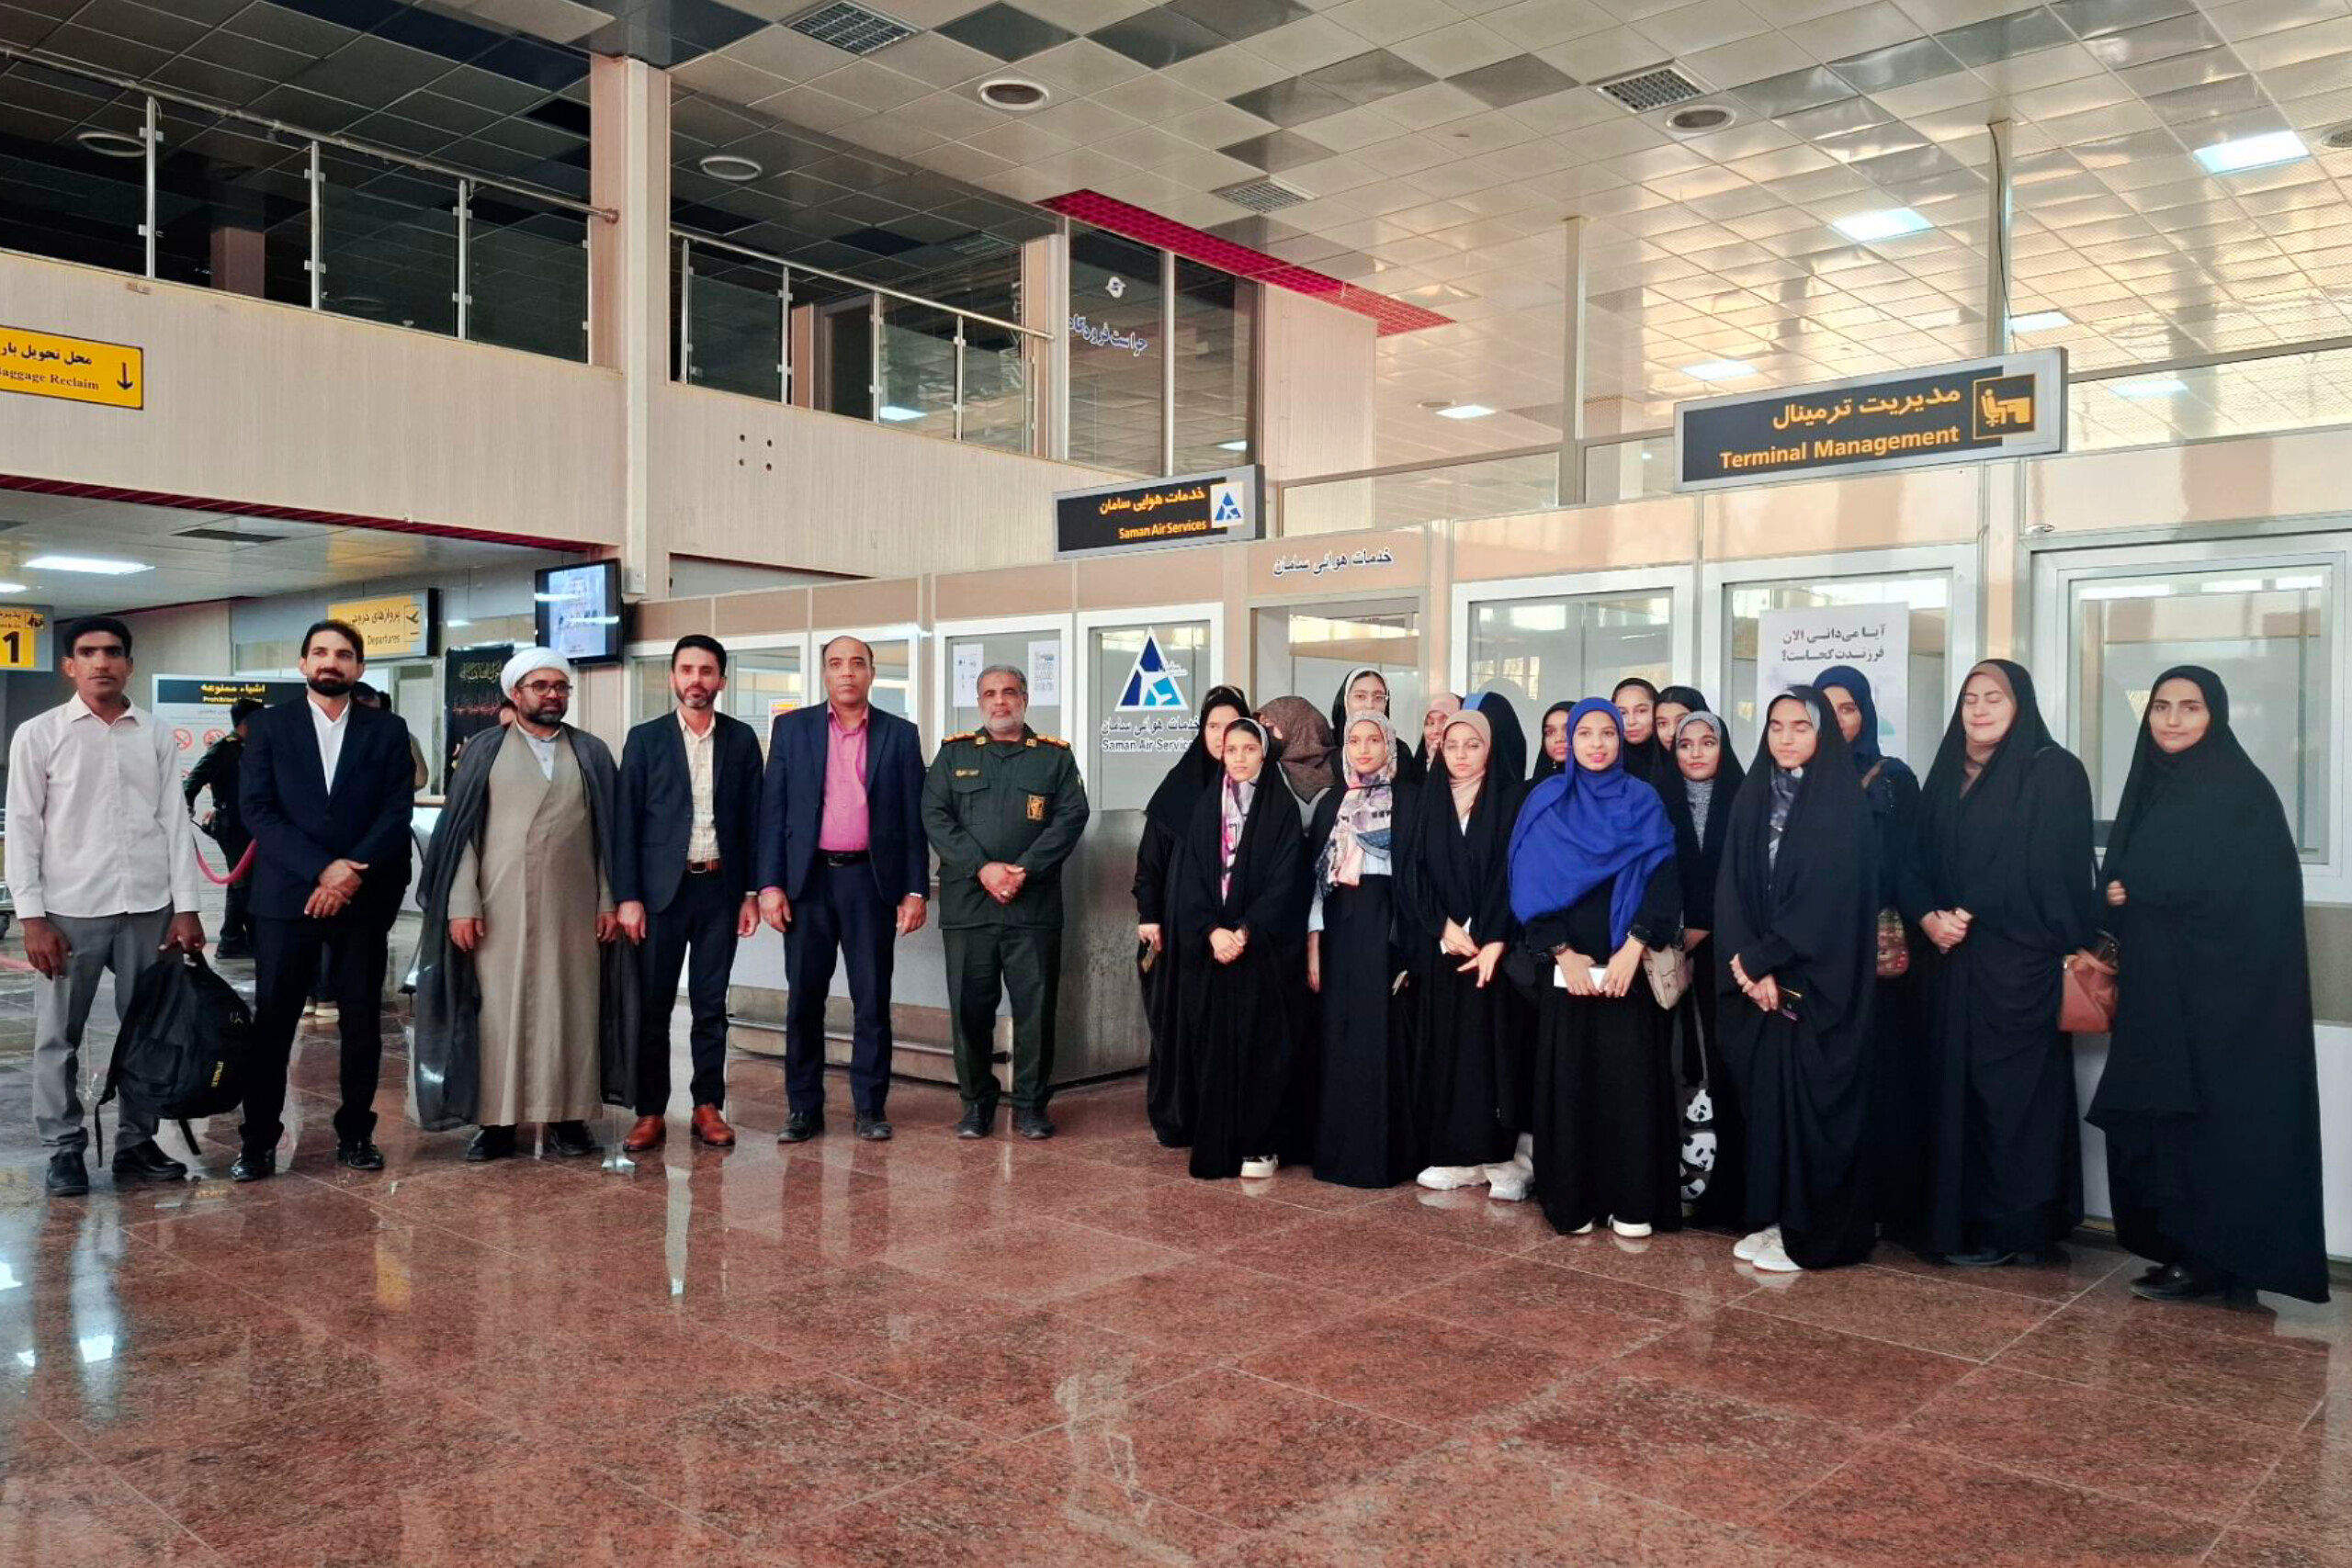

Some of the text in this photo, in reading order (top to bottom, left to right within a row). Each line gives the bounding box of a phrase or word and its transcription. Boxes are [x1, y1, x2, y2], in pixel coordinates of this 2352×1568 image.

[1110, 330, 1148, 357] حراست
[1, 342, 93, 365] محل تحویل بار
[50, 374, 99, 390] Reclaim
[1772, 387, 1961, 430] مدیریت ترمینال
[1719, 425, 1961, 469] Terminal Management
[1164, 486, 1205, 503] خدمات
[1099, 497, 1132, 514] سامان
[1118, 520, 1207, 539] Saman Air Services
[1351, 547, 1393, 565] خدمات
[1272, 554, 1310, 576] سامان
[368, 635, 401, 646] Departures
[1782, 629, 1804, 644] الان
[1861, 624, 1886, 640] آیا
[3, 631, 19, 663] 1
[1835, 647, 1884, 662] فرزندت
[200, 683, 238, 695] ممنوعه
[1102, 716, 1132, 736] سامان
[1102, 738, 1137, 752] Saman
[1139, 738, 1155, 752] Air
